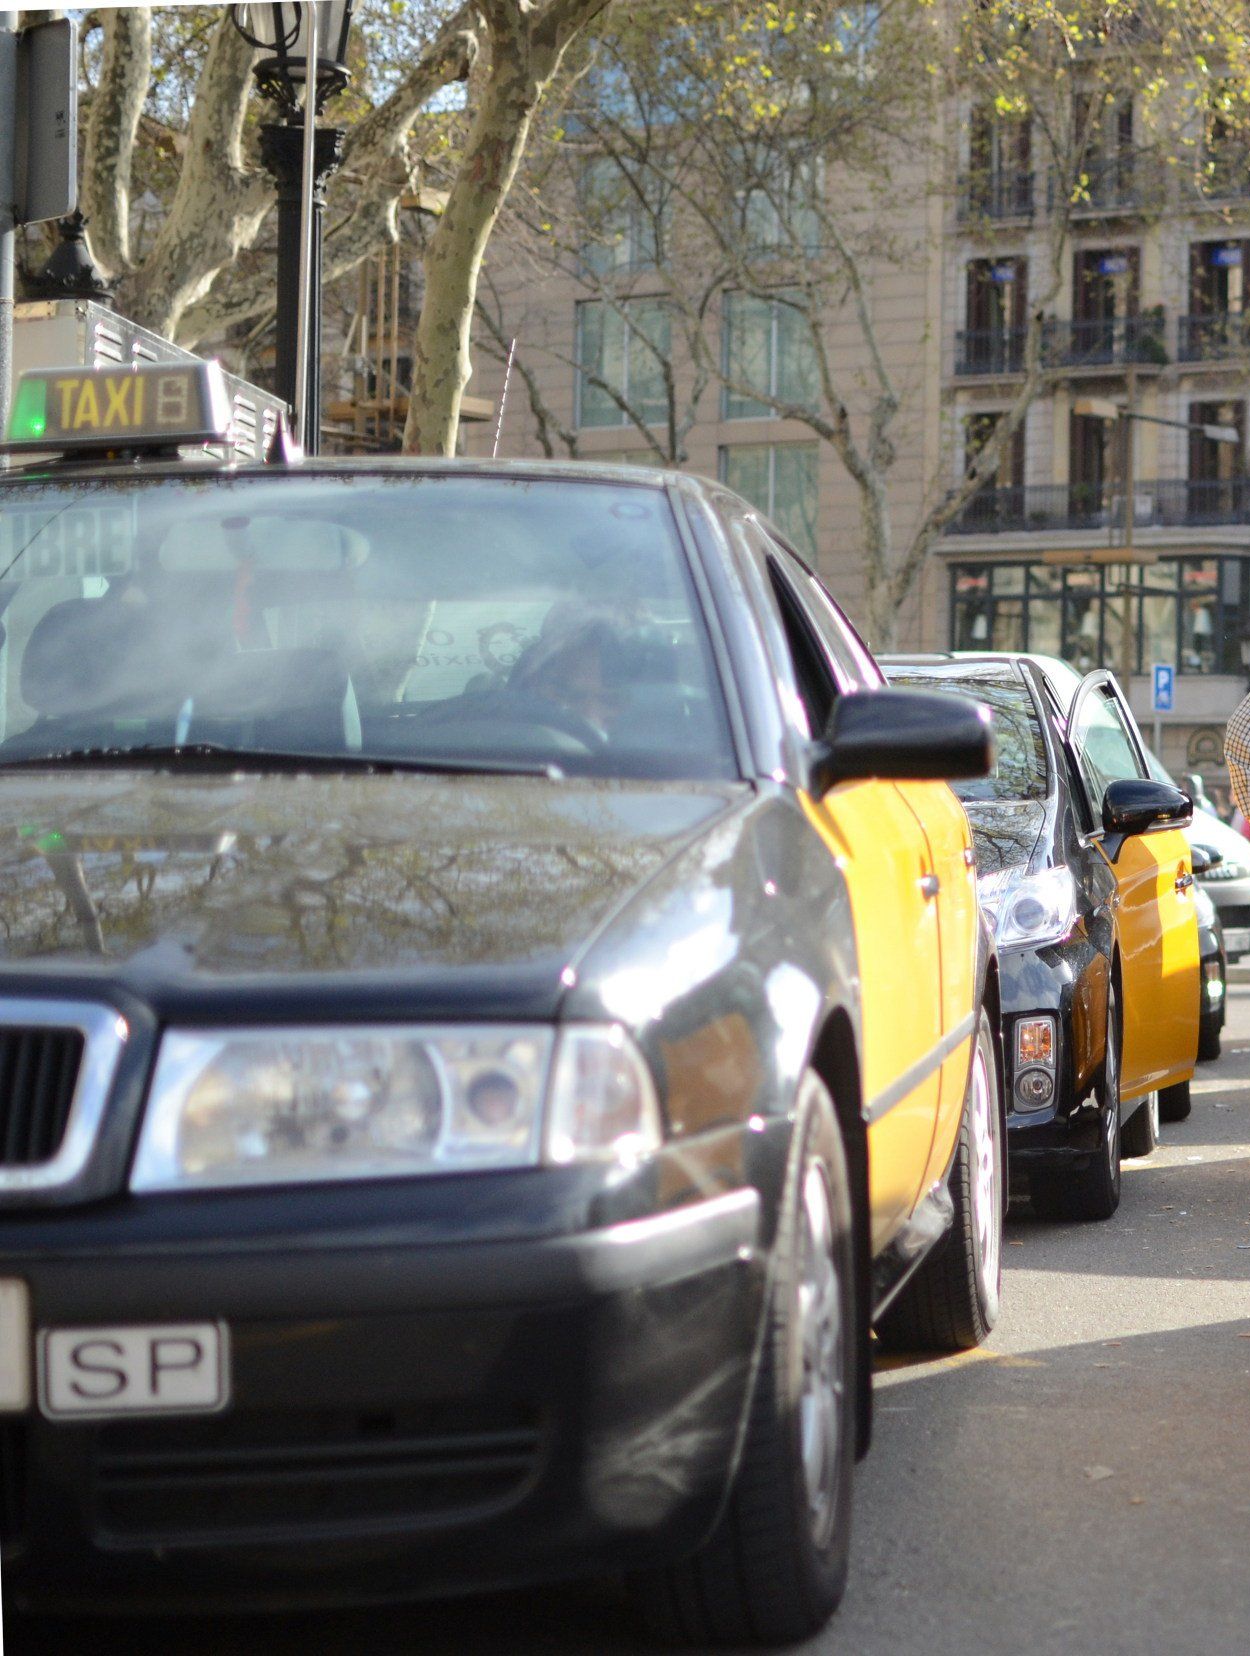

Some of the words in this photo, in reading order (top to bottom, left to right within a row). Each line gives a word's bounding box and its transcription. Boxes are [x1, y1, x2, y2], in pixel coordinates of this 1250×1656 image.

[56, 375, 146, 430] TAXI
[10, 509, 127, 578] IBRE
[1157, 670, 1170, 689] P
[70, 1337, 204, 1400] SP
